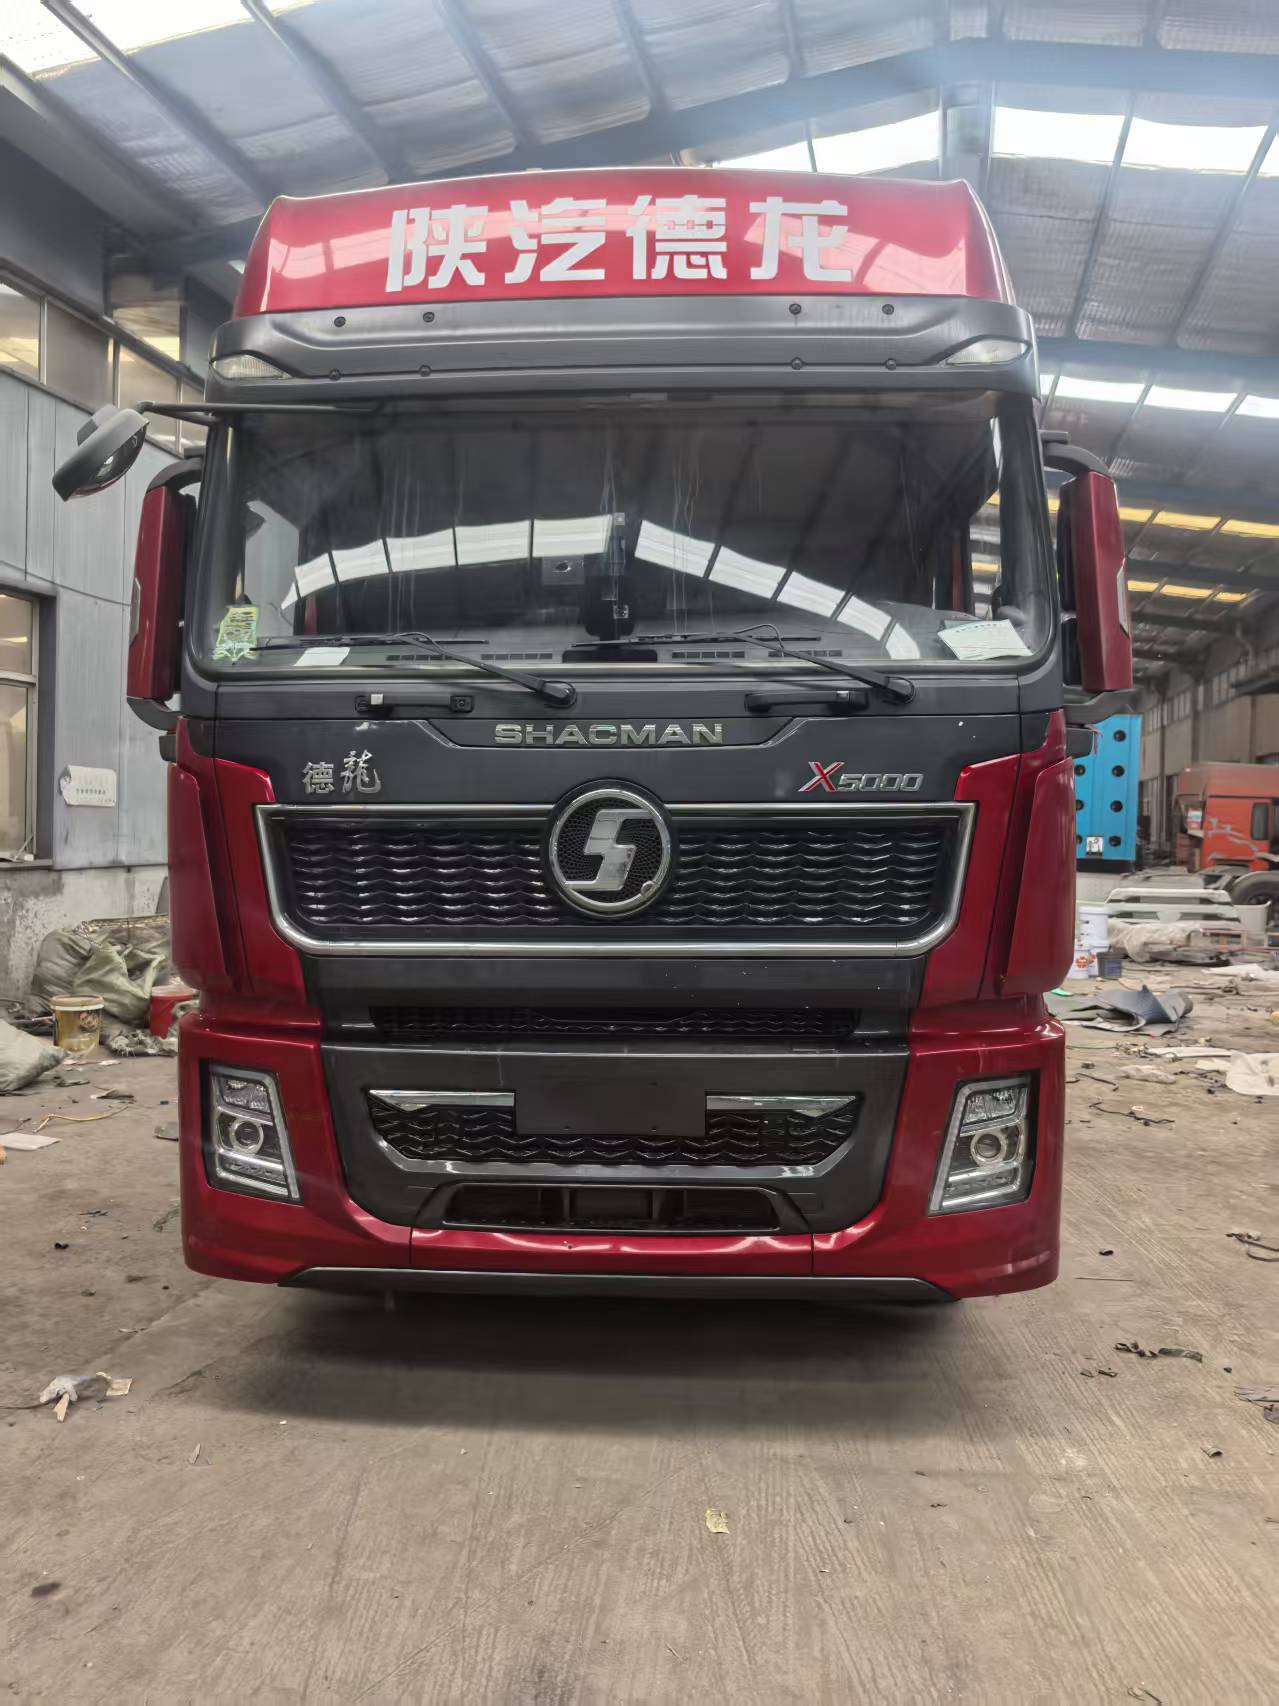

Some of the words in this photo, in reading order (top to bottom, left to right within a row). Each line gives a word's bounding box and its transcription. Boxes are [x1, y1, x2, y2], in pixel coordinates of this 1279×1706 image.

[385, 194, 852, 292] 陕汽德龙
[494, 723, 723, 745] SHACMAN
[798, 761, 924, 792] X5000
